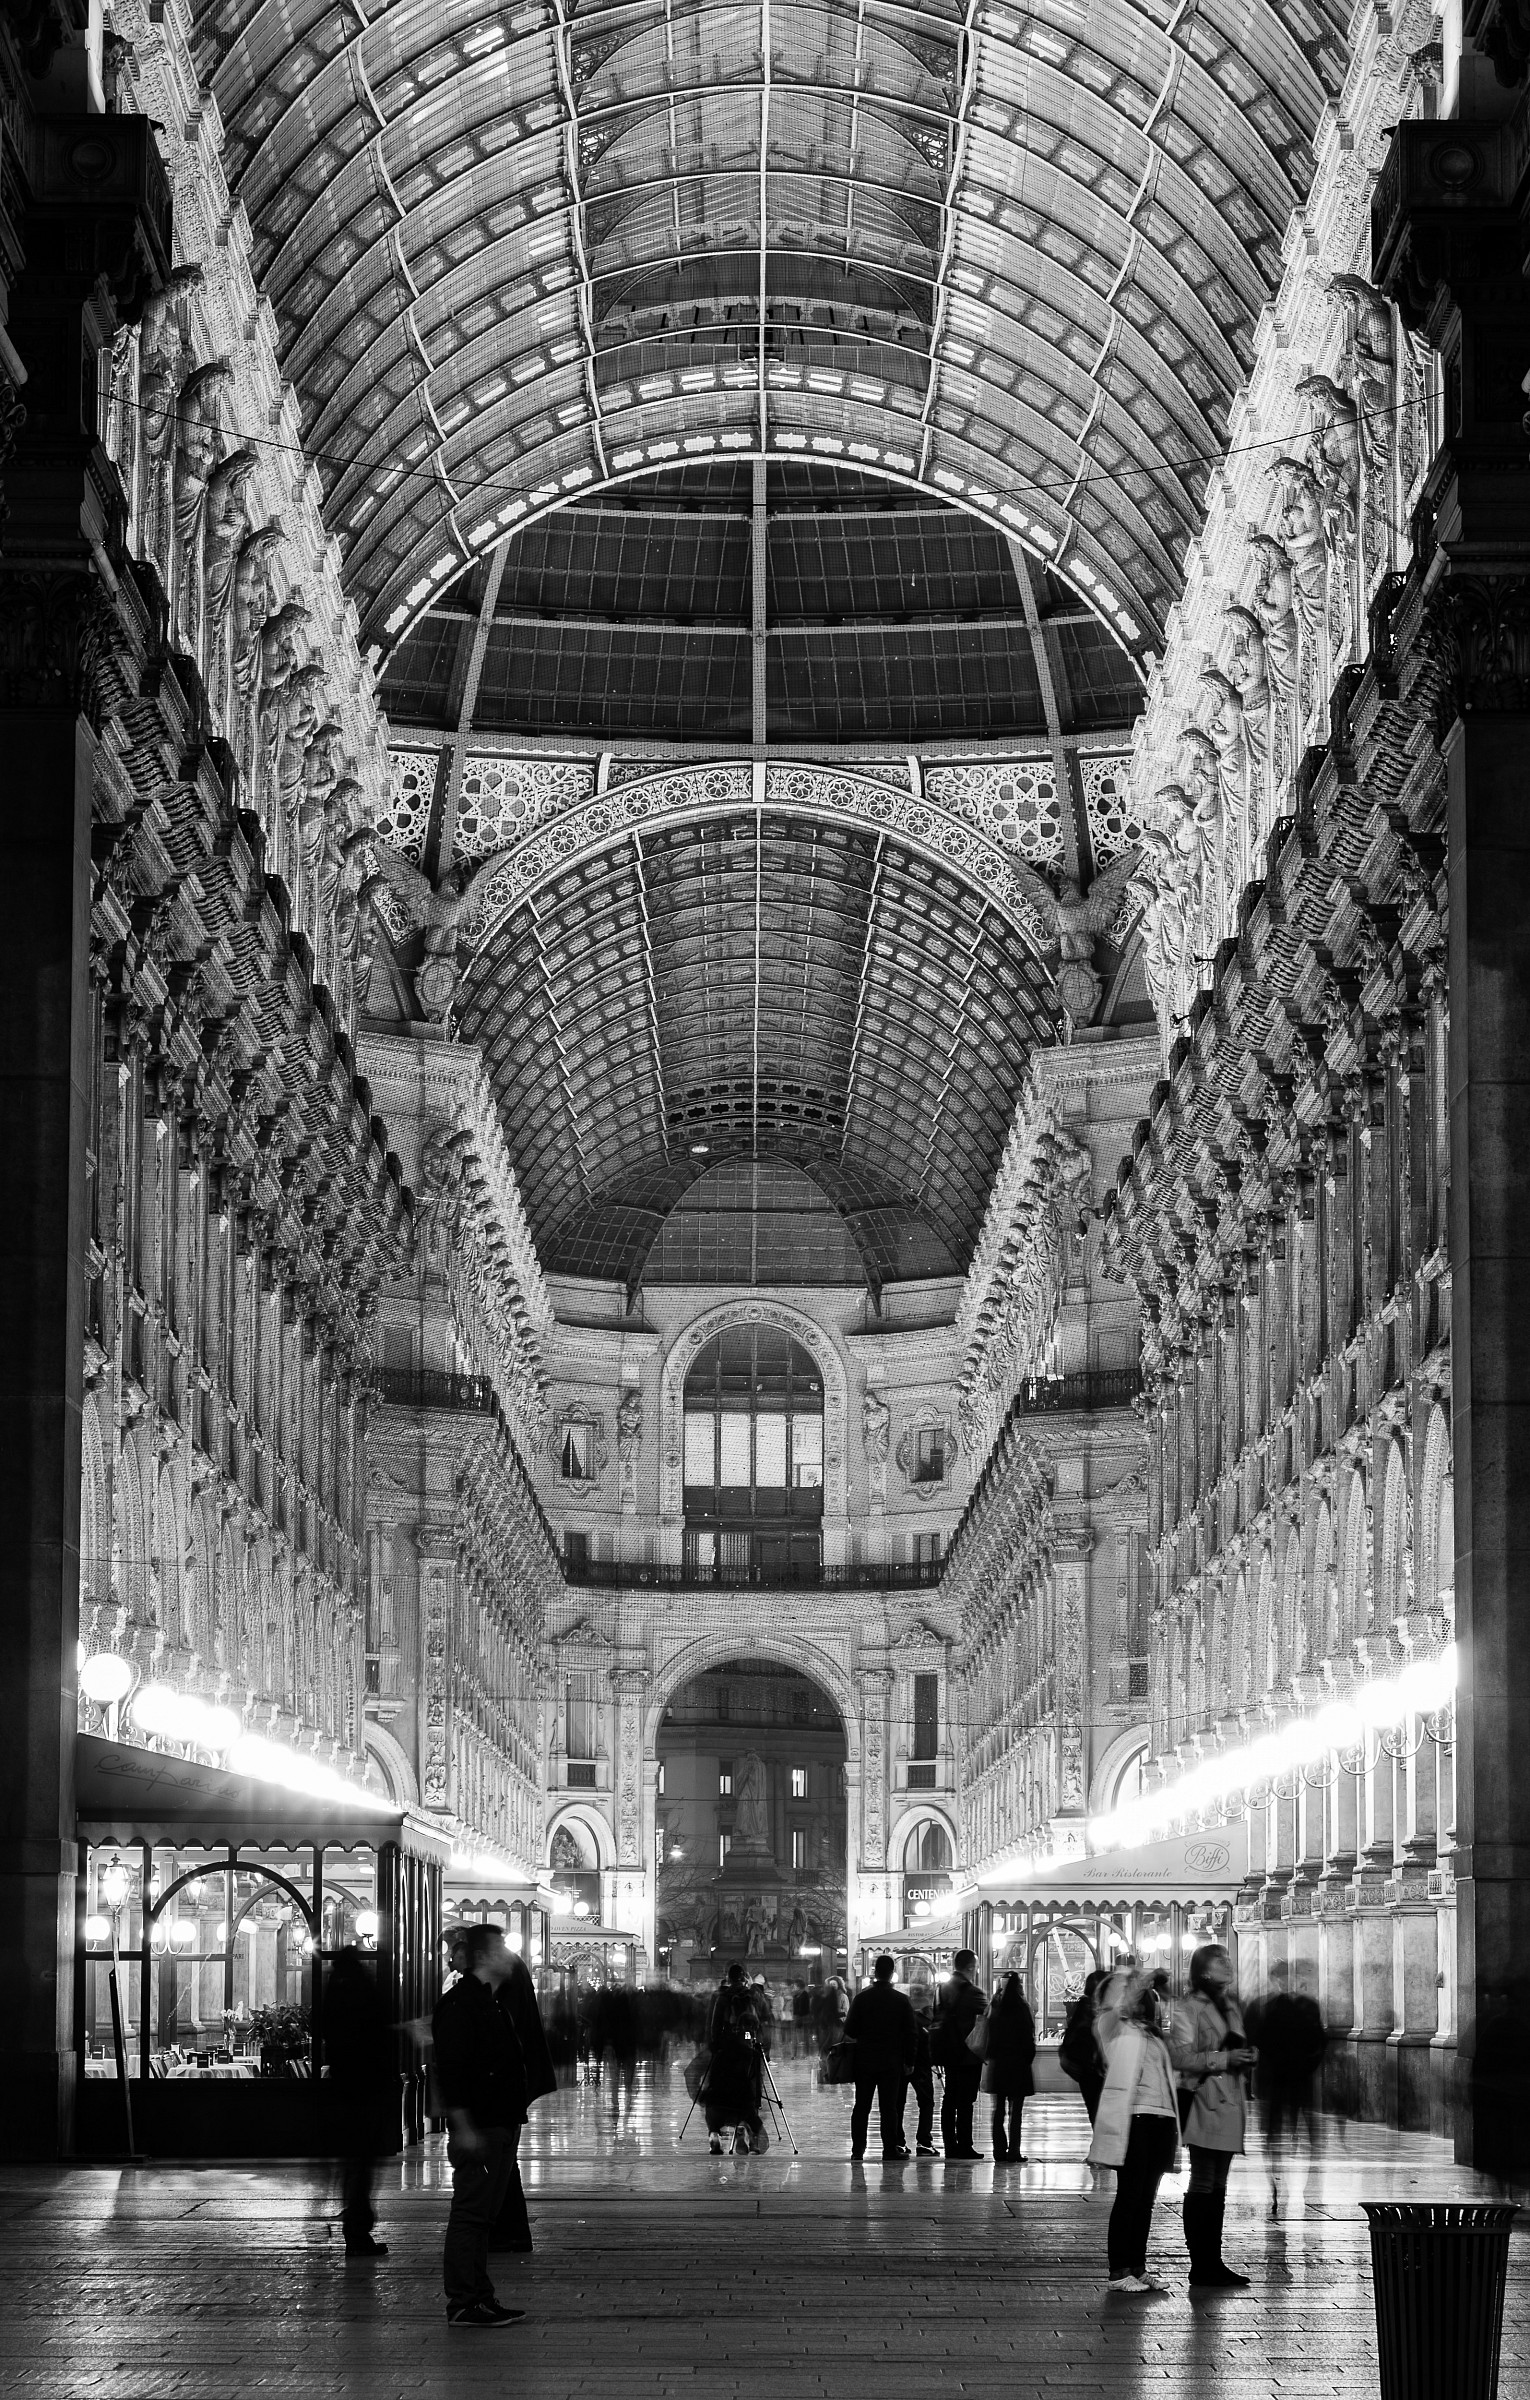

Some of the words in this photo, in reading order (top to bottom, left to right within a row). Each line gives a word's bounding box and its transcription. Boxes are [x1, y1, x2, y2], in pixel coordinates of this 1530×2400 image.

[1187, 1844, 1226, 1871] Biffi
[1083, 1867, 1108, 1878] Bar
[1111, 1867, 1172, 1878] Ristorante
